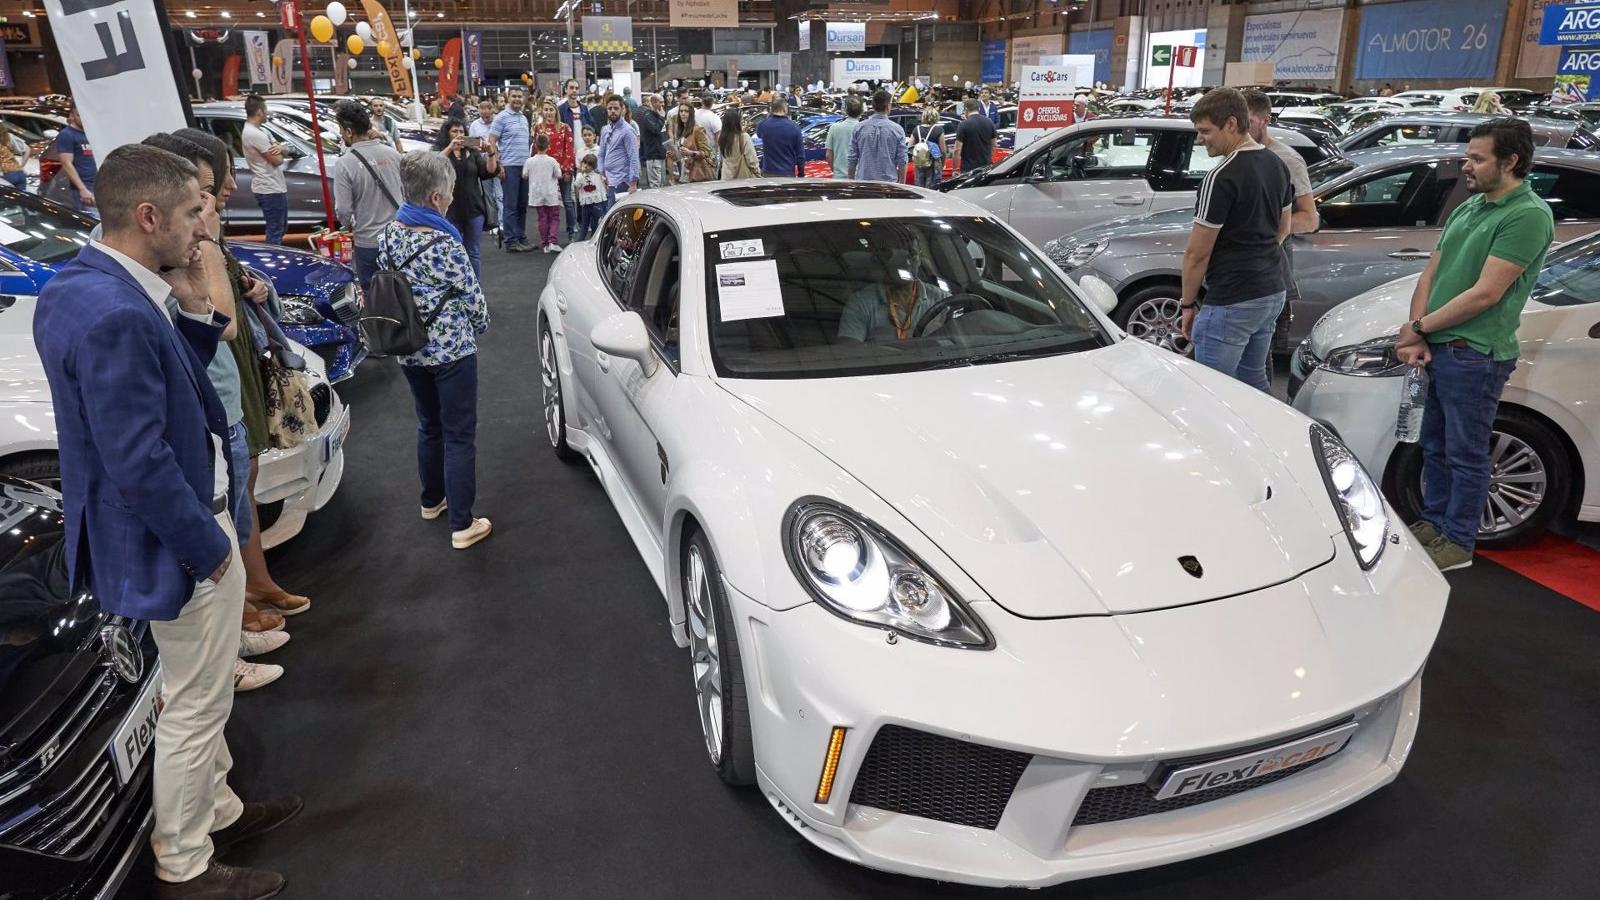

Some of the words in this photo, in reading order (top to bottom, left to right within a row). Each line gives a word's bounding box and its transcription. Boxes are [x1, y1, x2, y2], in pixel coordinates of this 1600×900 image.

[828, 30, 864, 42] Dursan
[1367, 28, 1452, 53] ALMOTOR
[1460, 23, 1488, 50] 26
[846, 60, 880, 72] Dursan
[1031, 70, 1068, 83] Cars&Cars
[1037, 106, 1060, 115] OFERTAS
[1037, 114, 1068, 122] EXCLUSIVAS
